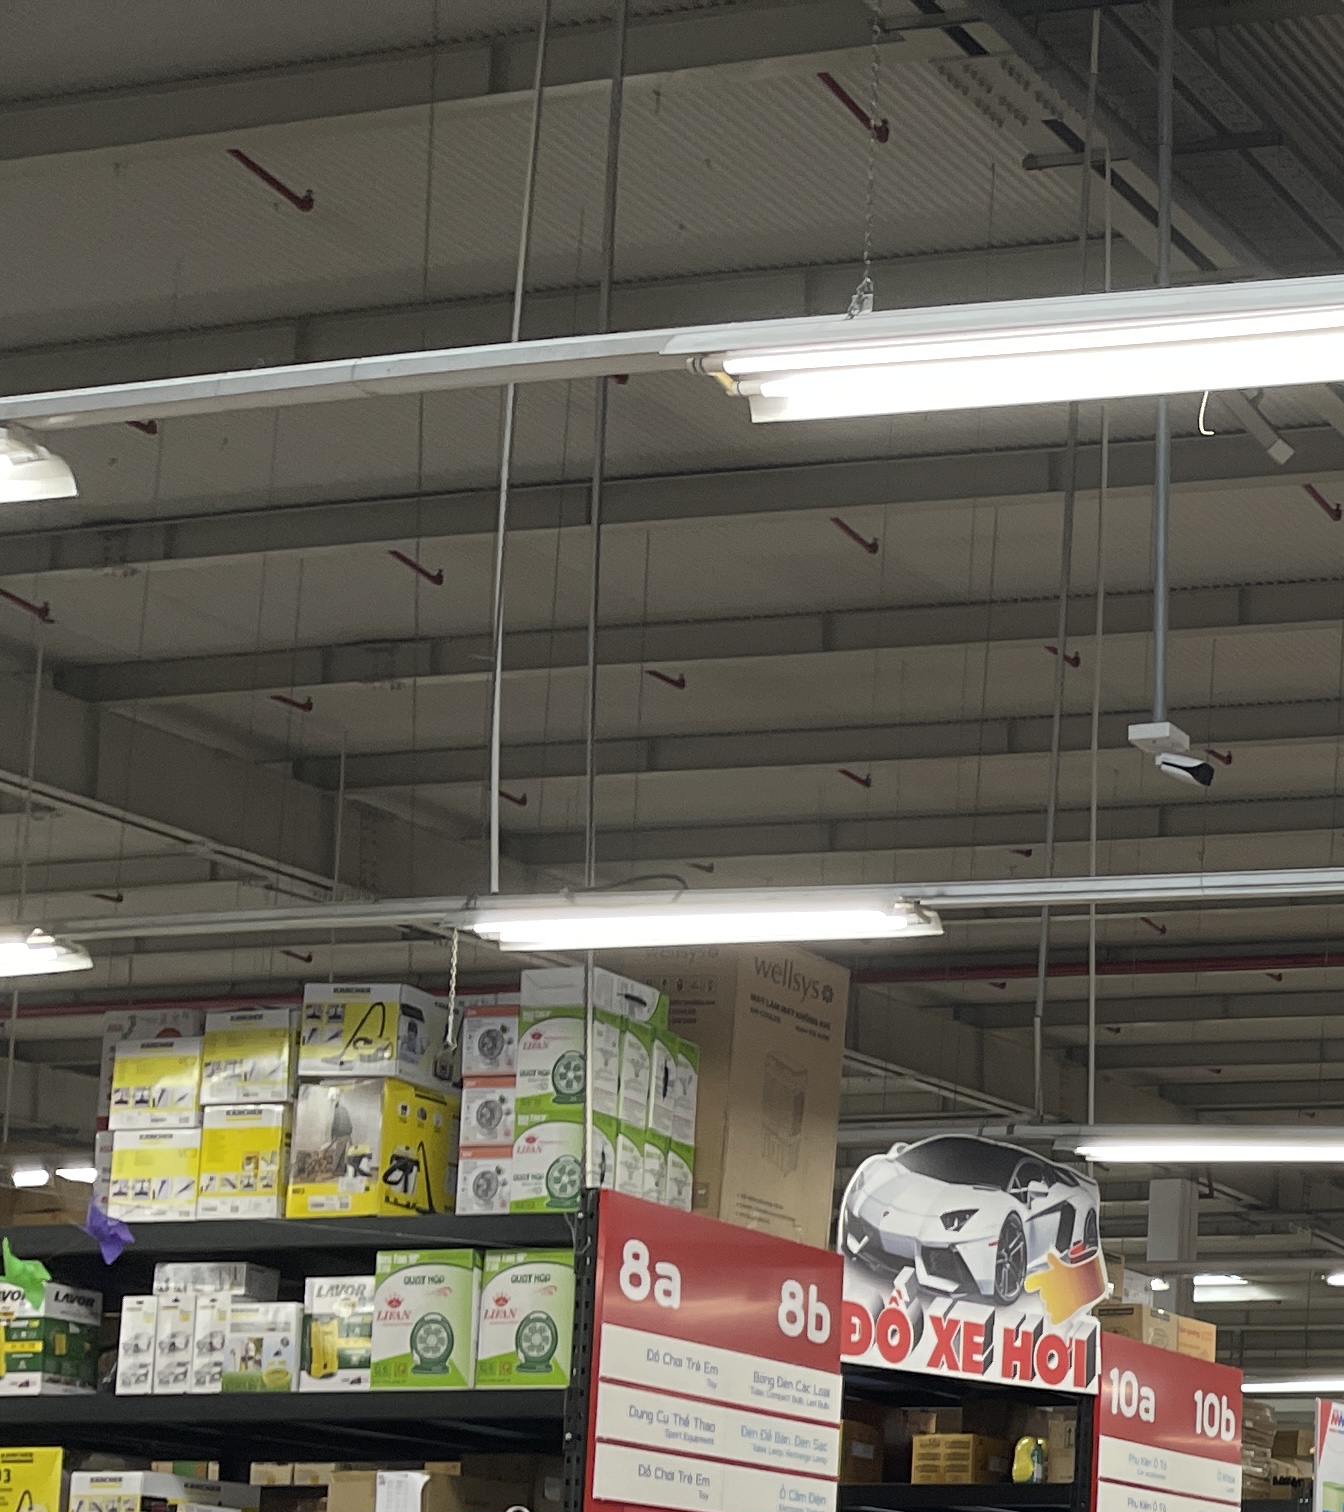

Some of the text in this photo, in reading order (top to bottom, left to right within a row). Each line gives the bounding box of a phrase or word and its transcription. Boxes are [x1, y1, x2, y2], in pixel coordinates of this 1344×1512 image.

[753, 955, 821, 1001] wellsys
[54, 1290, 96, 1307] LAVOR
[316, 1283, 367, 1299] LAVOR
[620, 1239, 682, 1310] 8a
[778, 1279, 831, 1344] 8b
[926, 1313, 987, 1375] XE
[1110, 1367, 1156, 1423] 10a
[1194, 1389, 1236, 1441] 10b
